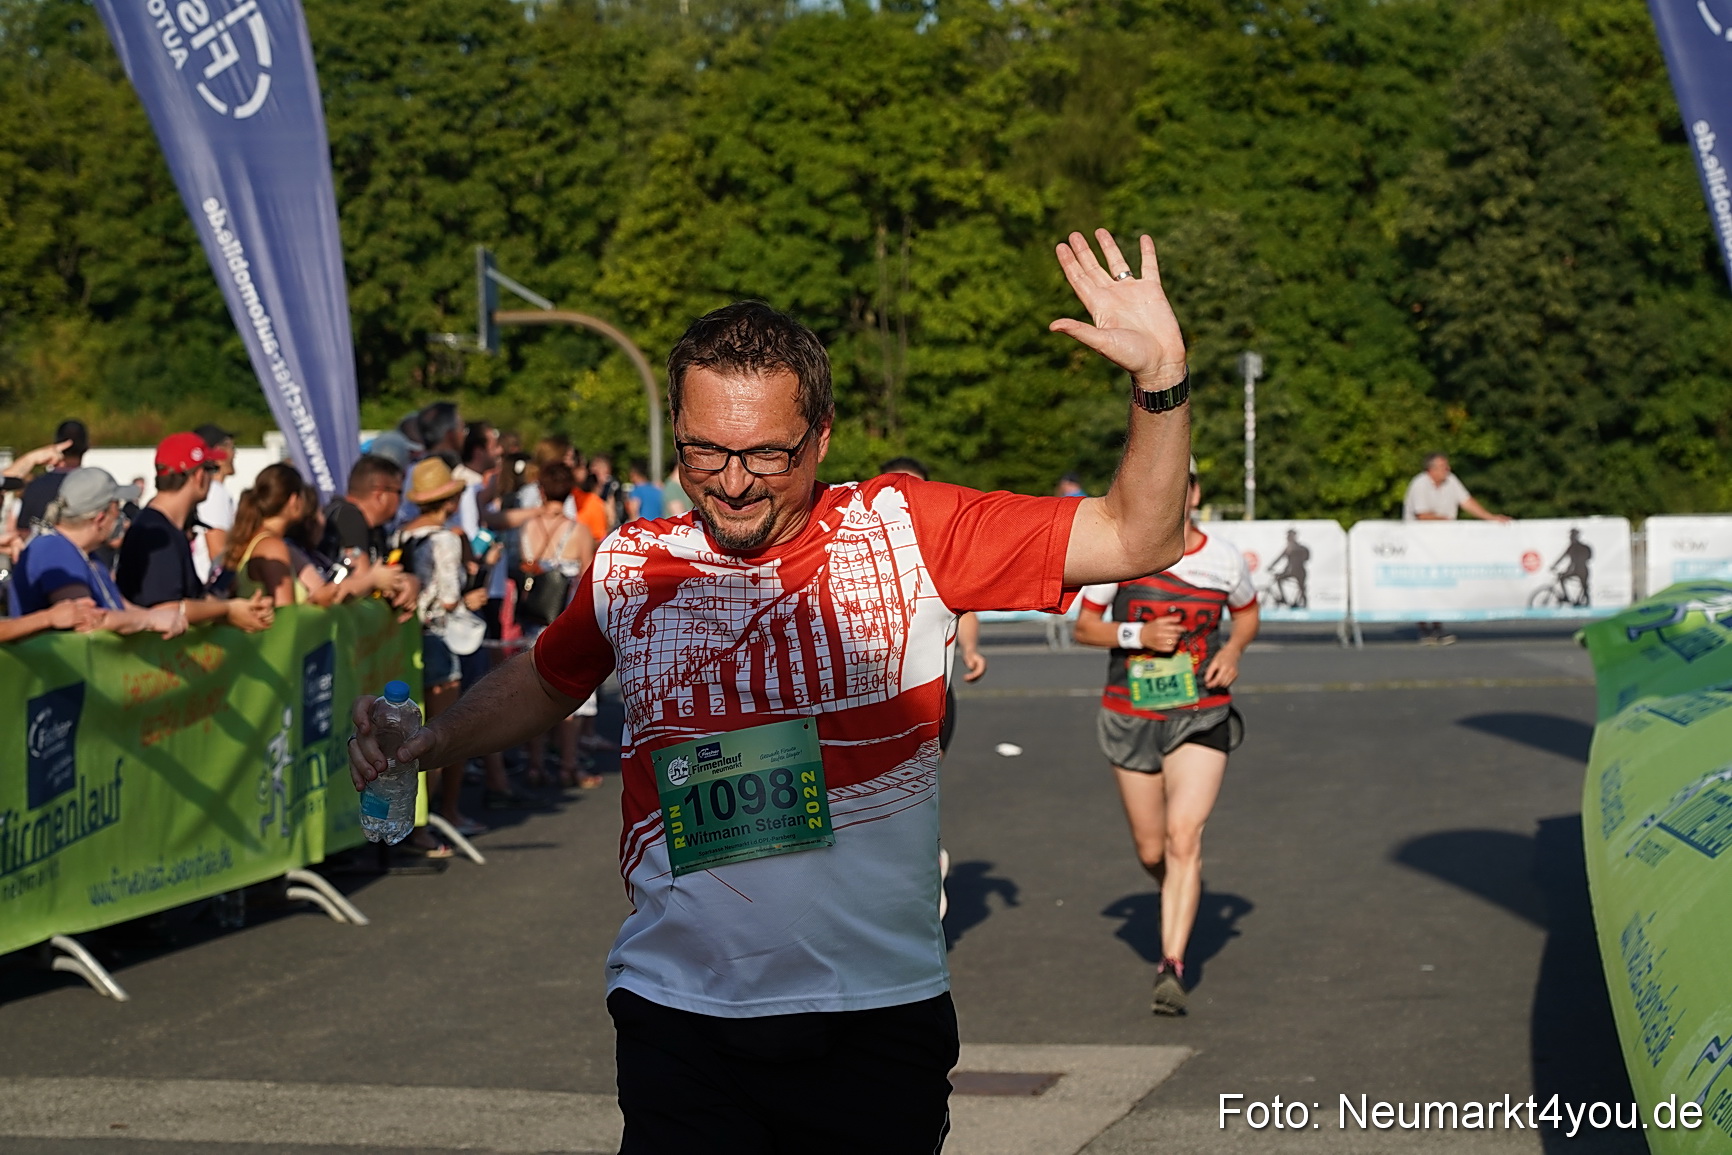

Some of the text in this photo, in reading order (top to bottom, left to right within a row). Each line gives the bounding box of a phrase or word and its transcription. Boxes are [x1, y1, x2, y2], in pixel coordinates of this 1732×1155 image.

[1145, 674, 1179, 693] 164
[692, 752, 742, 774] Firmenlauf
[711, 761, 743, 775] neumarkt
[684, 767, 799, 827] 1098
[800, 770, 823, 830] 2022
[668, 804, 686, 850] RUN
[684, 813, 807, 848] Witmann Stefan
